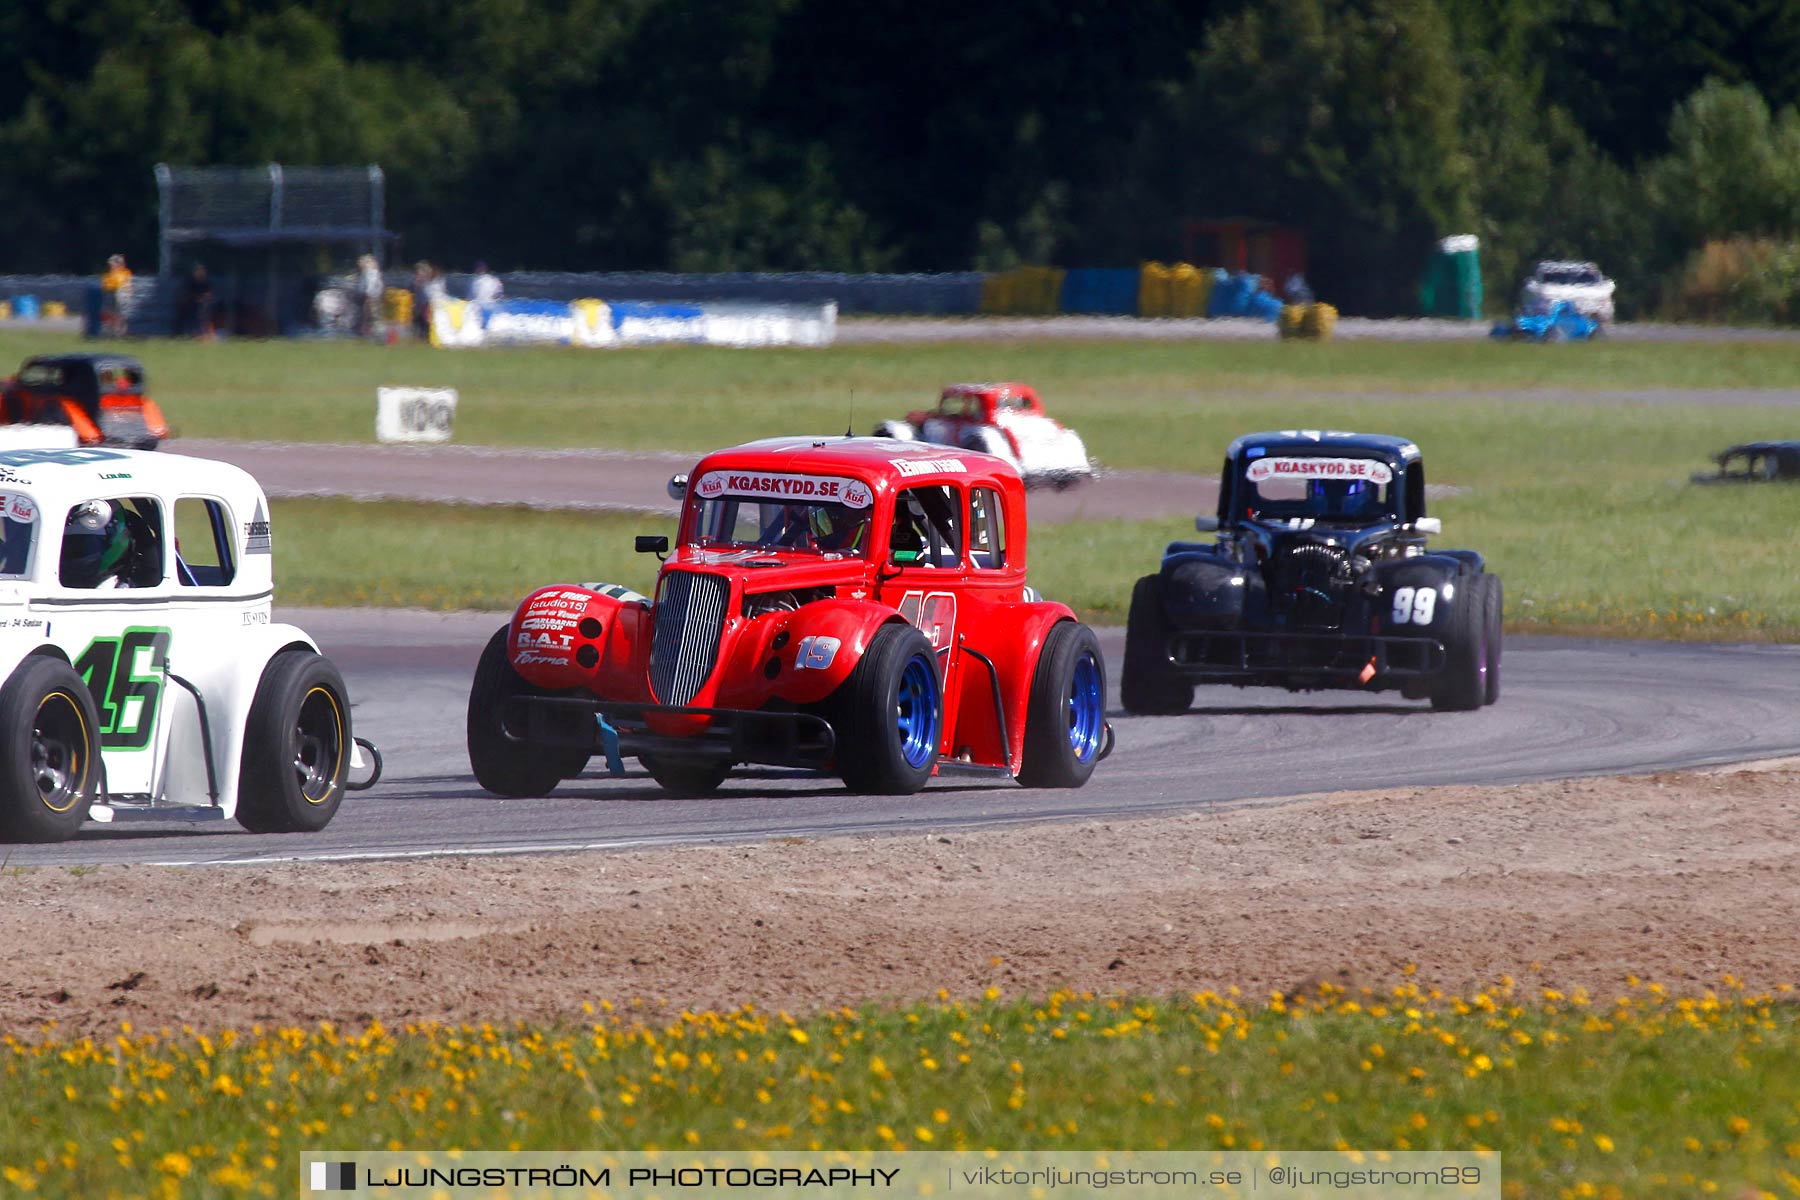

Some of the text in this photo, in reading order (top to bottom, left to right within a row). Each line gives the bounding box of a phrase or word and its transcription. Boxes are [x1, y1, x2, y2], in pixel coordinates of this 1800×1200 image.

[702, 481, 722, 493] KGA
[728, 475, 839, 497] KGASKYDD.SE
[844, 489, 866, 503] KGA
[1392, 586, 1437, 626] 99
[794, 635, 842, 670] 19
[72, 625, 173, 752] 46
